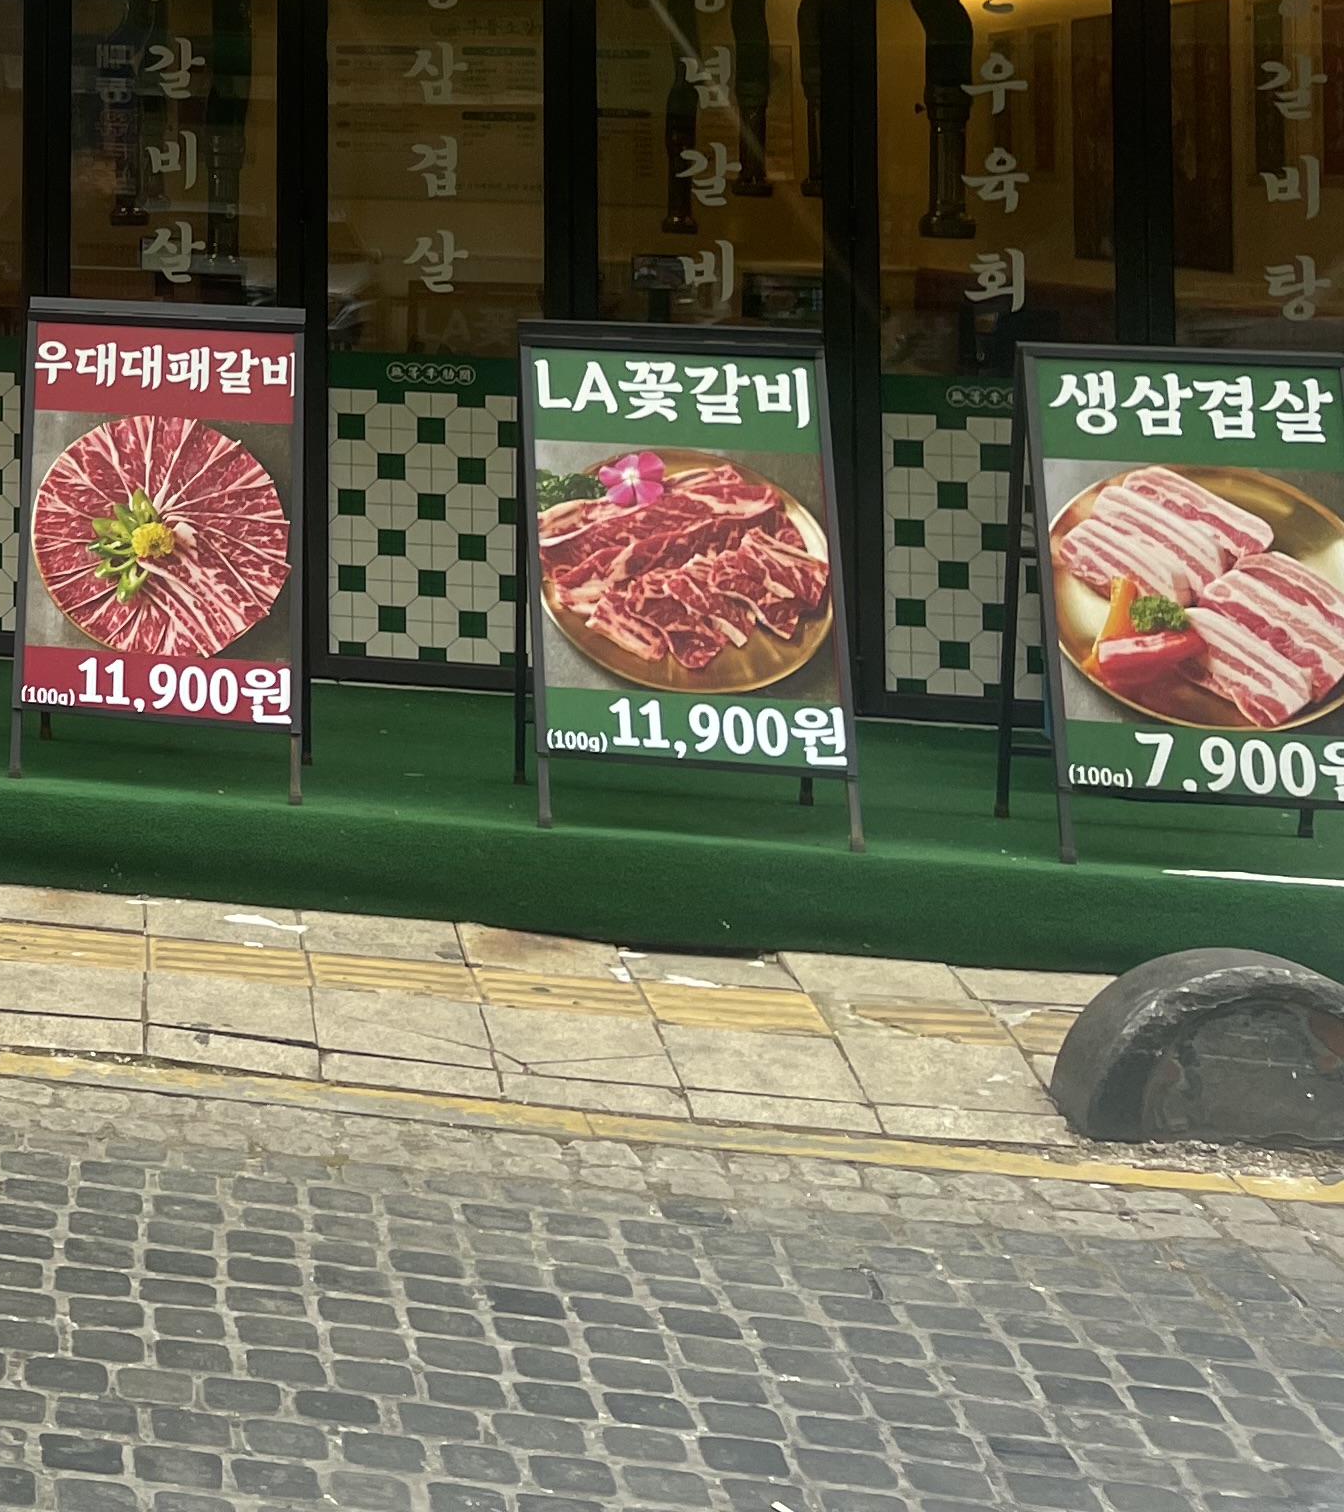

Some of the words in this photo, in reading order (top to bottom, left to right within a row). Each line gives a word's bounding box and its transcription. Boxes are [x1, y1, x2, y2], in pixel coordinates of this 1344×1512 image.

[34, 341, 296, 397] 우대대패갈비
[534, 359, 810, 428] LA꽃갈비
[1049, 370, 1333, 443] 생삼겹살
[78, 657, 292, 724] 11,900원
[546, 728, 608, 753] (100g)
[609, 697, 848, 766] 11,900원
